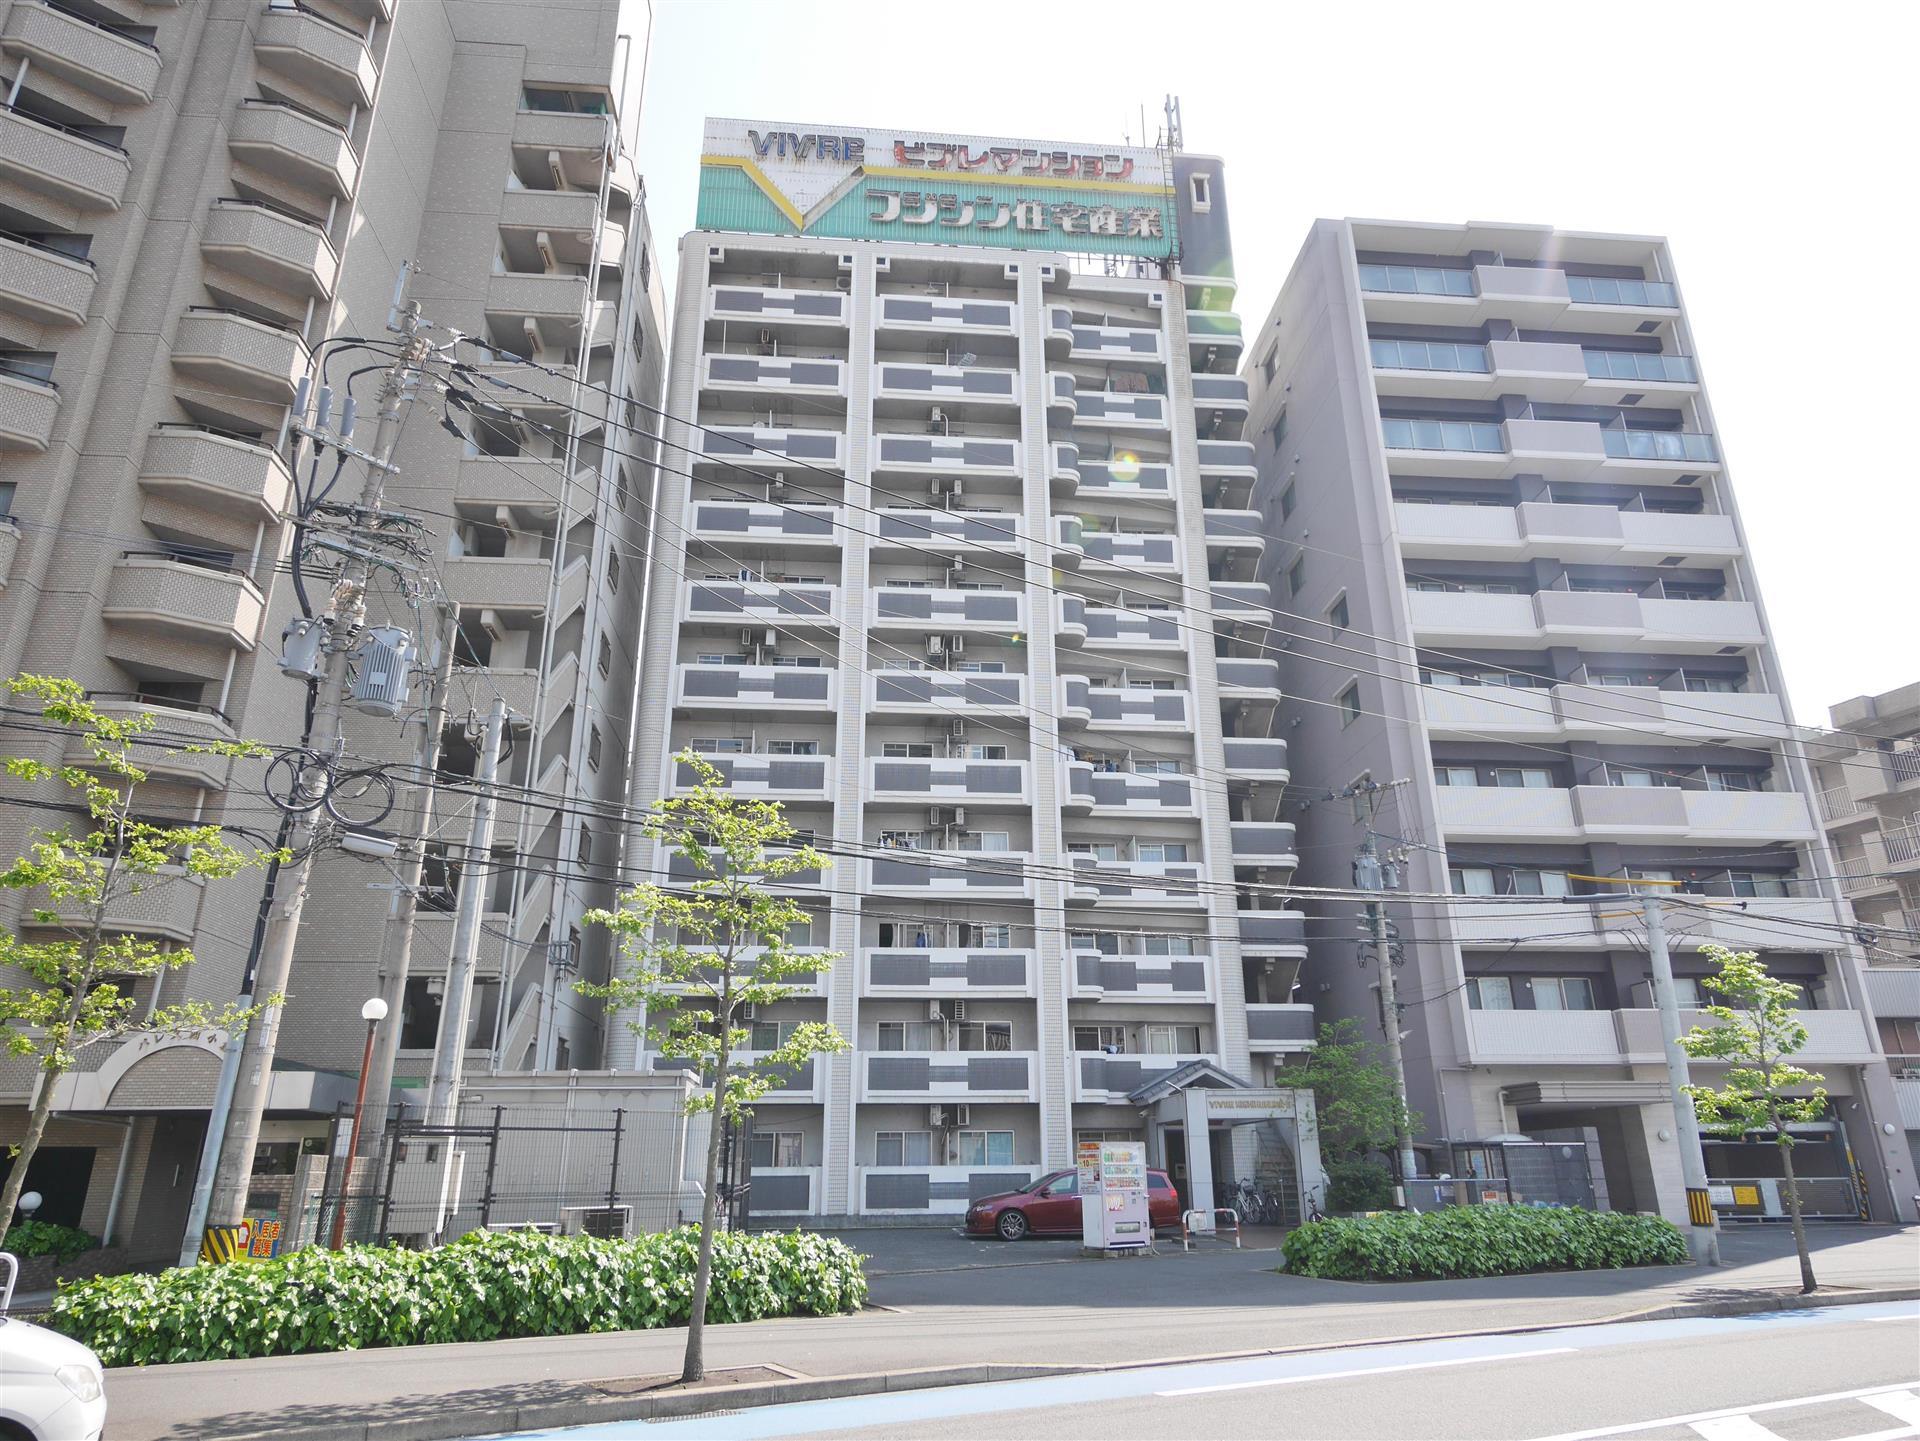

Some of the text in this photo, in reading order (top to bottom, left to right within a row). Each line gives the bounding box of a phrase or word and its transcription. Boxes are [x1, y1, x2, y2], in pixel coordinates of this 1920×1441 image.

[748, 130, 865, 162] VIVRE
[894, 140, 1134, 179] ビブレマンション
[865, 188, 1164, 239] フジシン住宅産業
[252, 1220, 281, 1240] 入居者
[252, 1239, 273, 1257] 募集
